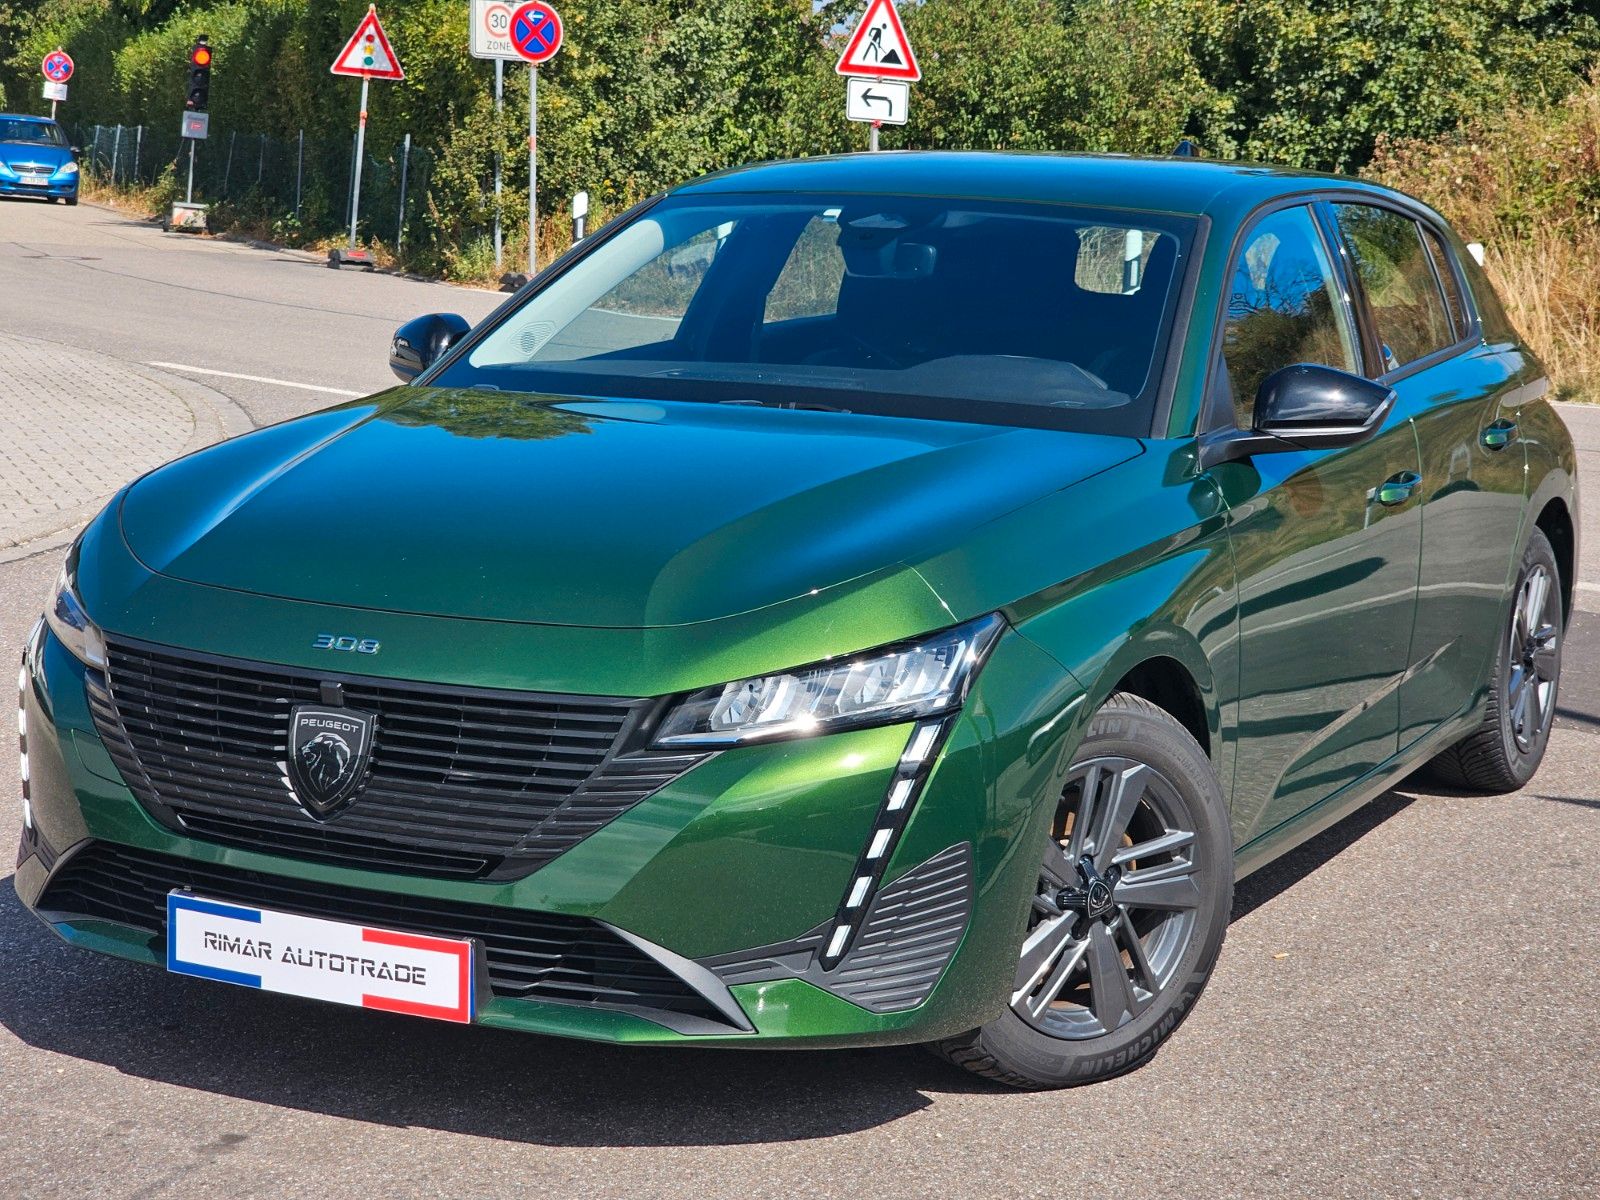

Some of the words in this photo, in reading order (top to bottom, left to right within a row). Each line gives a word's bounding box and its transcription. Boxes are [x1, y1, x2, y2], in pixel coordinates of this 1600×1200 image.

[491, 14, 507, 29] 30
[486, 41, 511, 51] ZONE
[312, 634, 380, 654] 308
[300, 718, 359, 733] PEUGEOT
[204, 930, 272, 960] RIMAR
[281, 945, 426, 986] AUTOTRADE
[1079, 1011, 1176, 1076] MICHELIN
